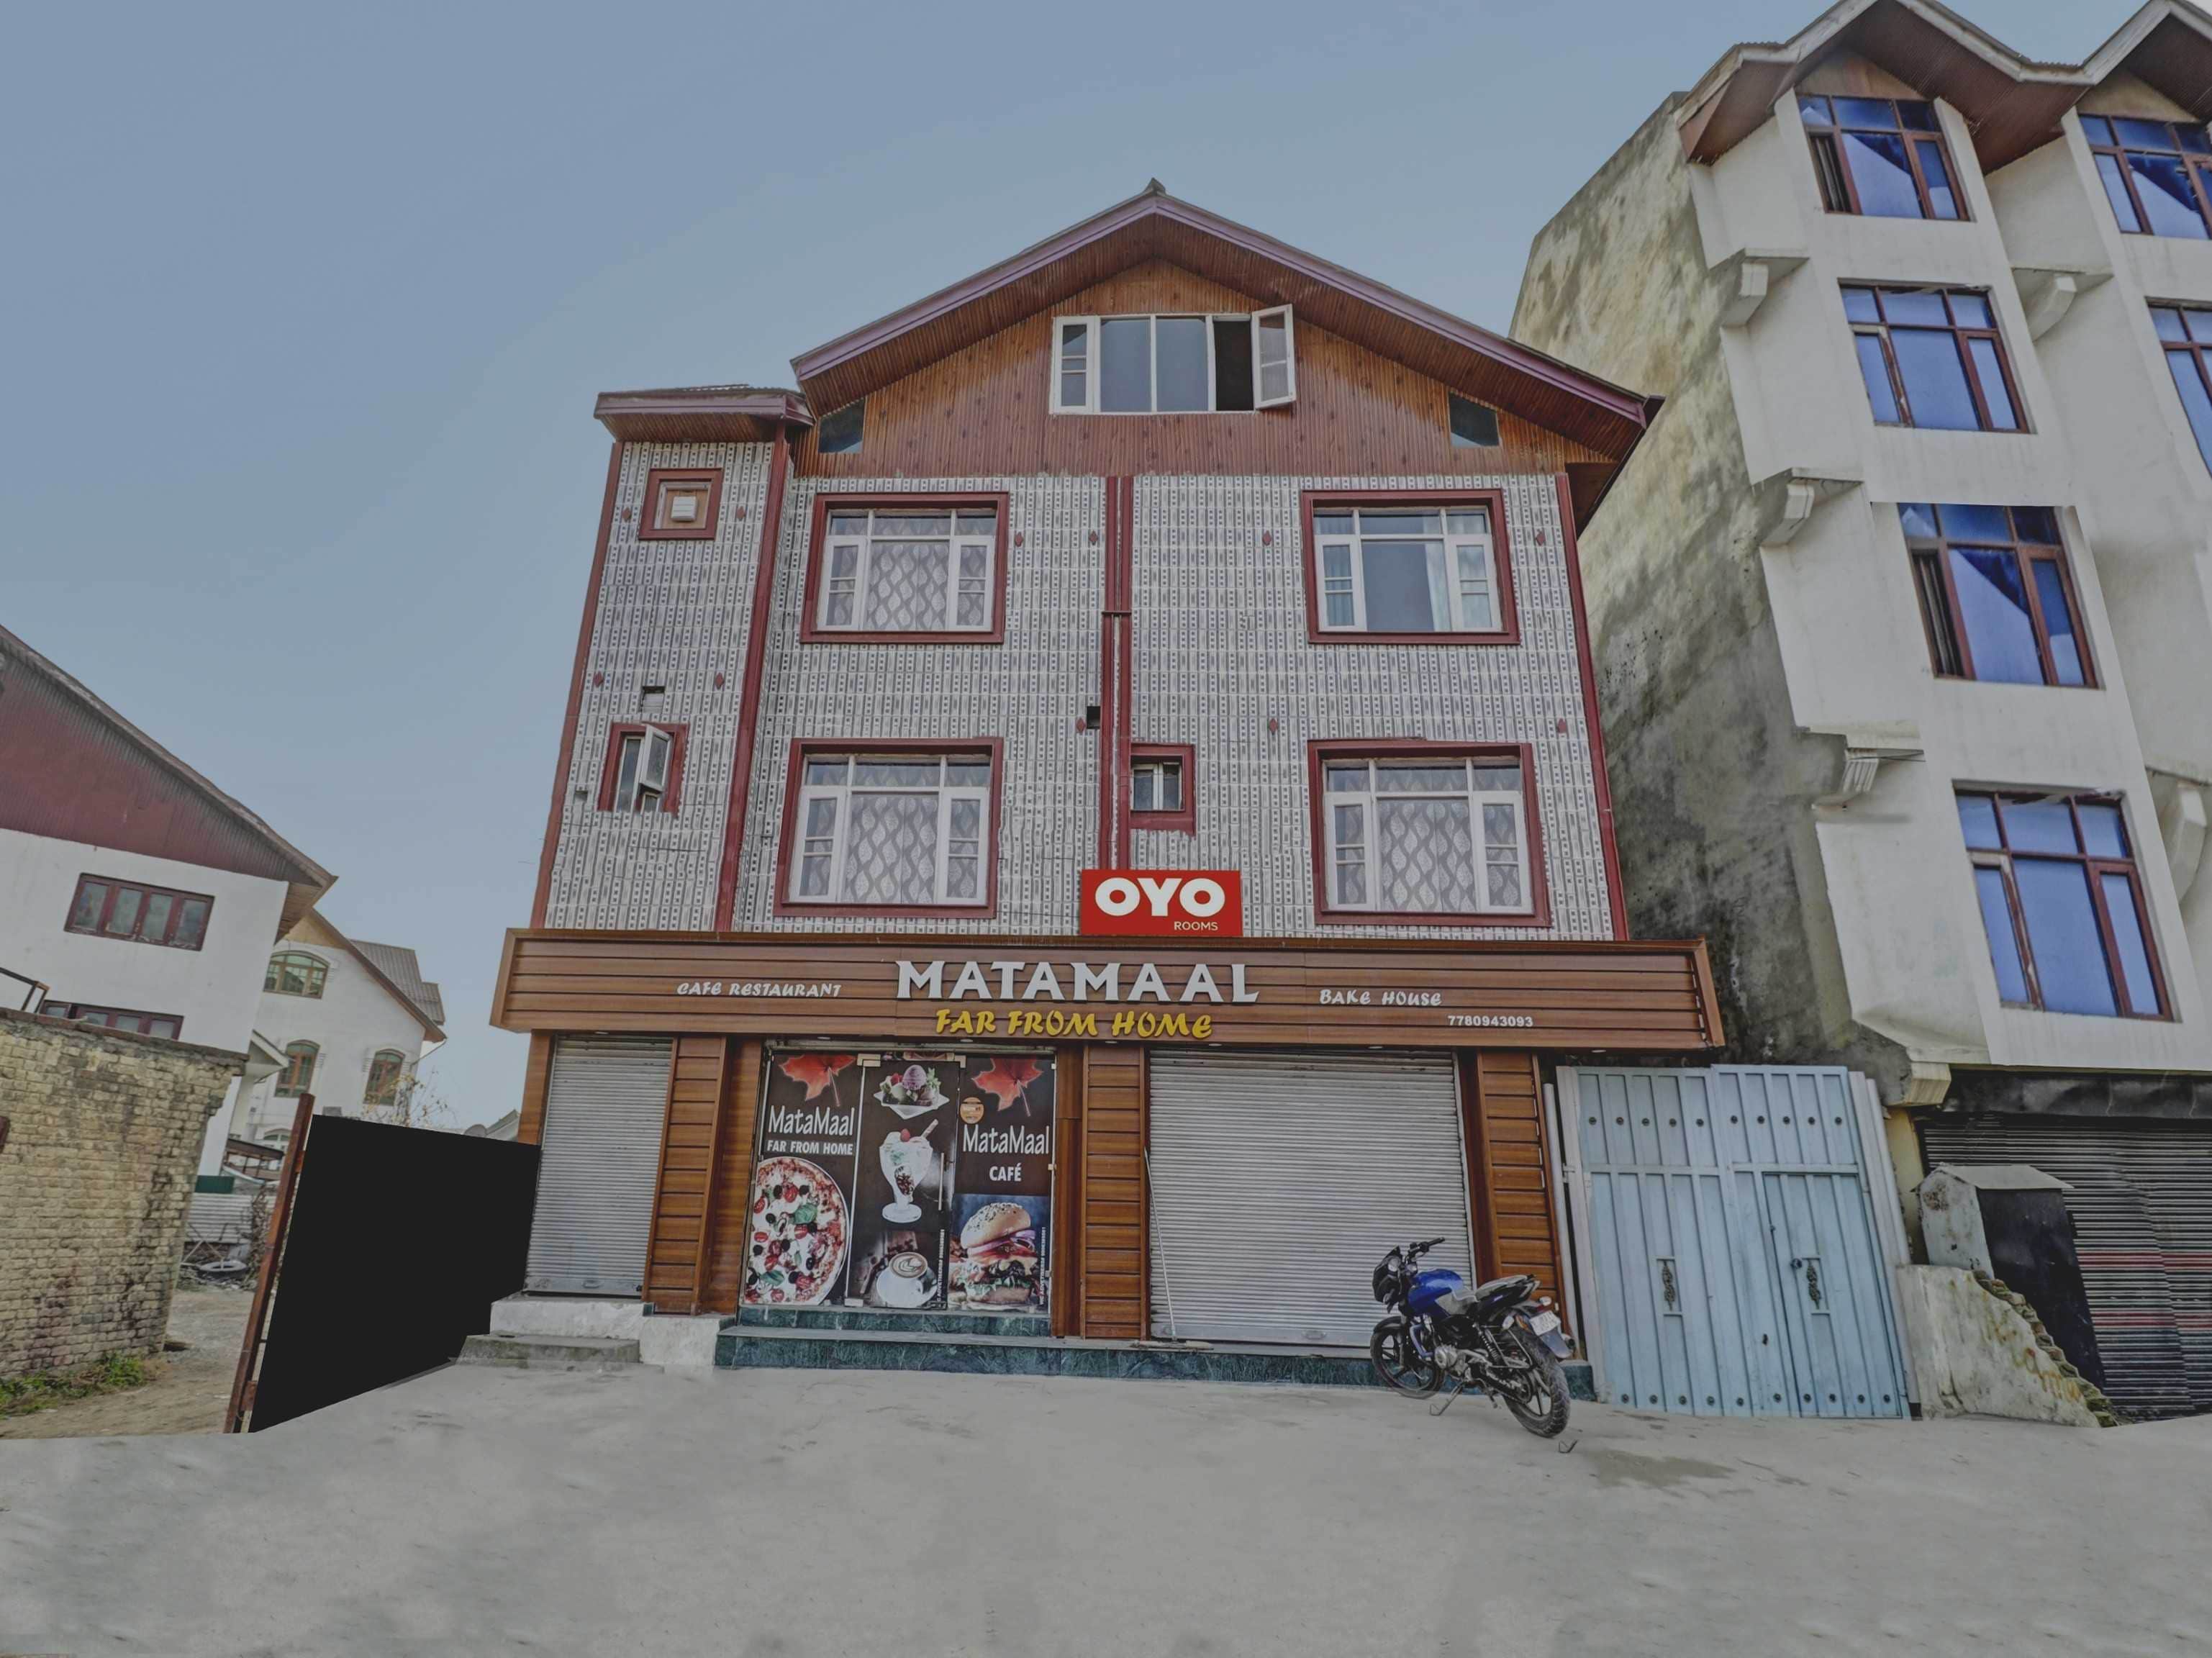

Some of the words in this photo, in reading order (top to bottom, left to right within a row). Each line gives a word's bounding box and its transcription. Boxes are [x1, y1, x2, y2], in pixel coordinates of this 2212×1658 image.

[1094, 877, 1225, 917] OYO
[1174, 921, 1219, 931] ROOMS
[676, 981, 722, 996] CAFE
[728, 982, 842, 998] RESTAURANT
[894, 960, 1260, 1003] MATAMAAL
[1319, 989, 1372, 1005] BAKE
[1381, 990, 1443, 1007] HOUSE
[935, 1009, 996, 1034] FAR
[1007, 1010, 1099, 1036] FROM
[1111, 1010, 1213, 1038] HOME
[1447, 1015, 1534, 1027] 7780943093
[768, 1105, 855, 1136] MataMaal
[767, 1139, 787, 1153] FAR
[790, 1141, 820, 1154] FROM
[822, 1142, 853, 1156] HOME
[963, 1124, 1050, 1155] MataMaal
[989, 1162, 1022, 1182] CAFÉ
